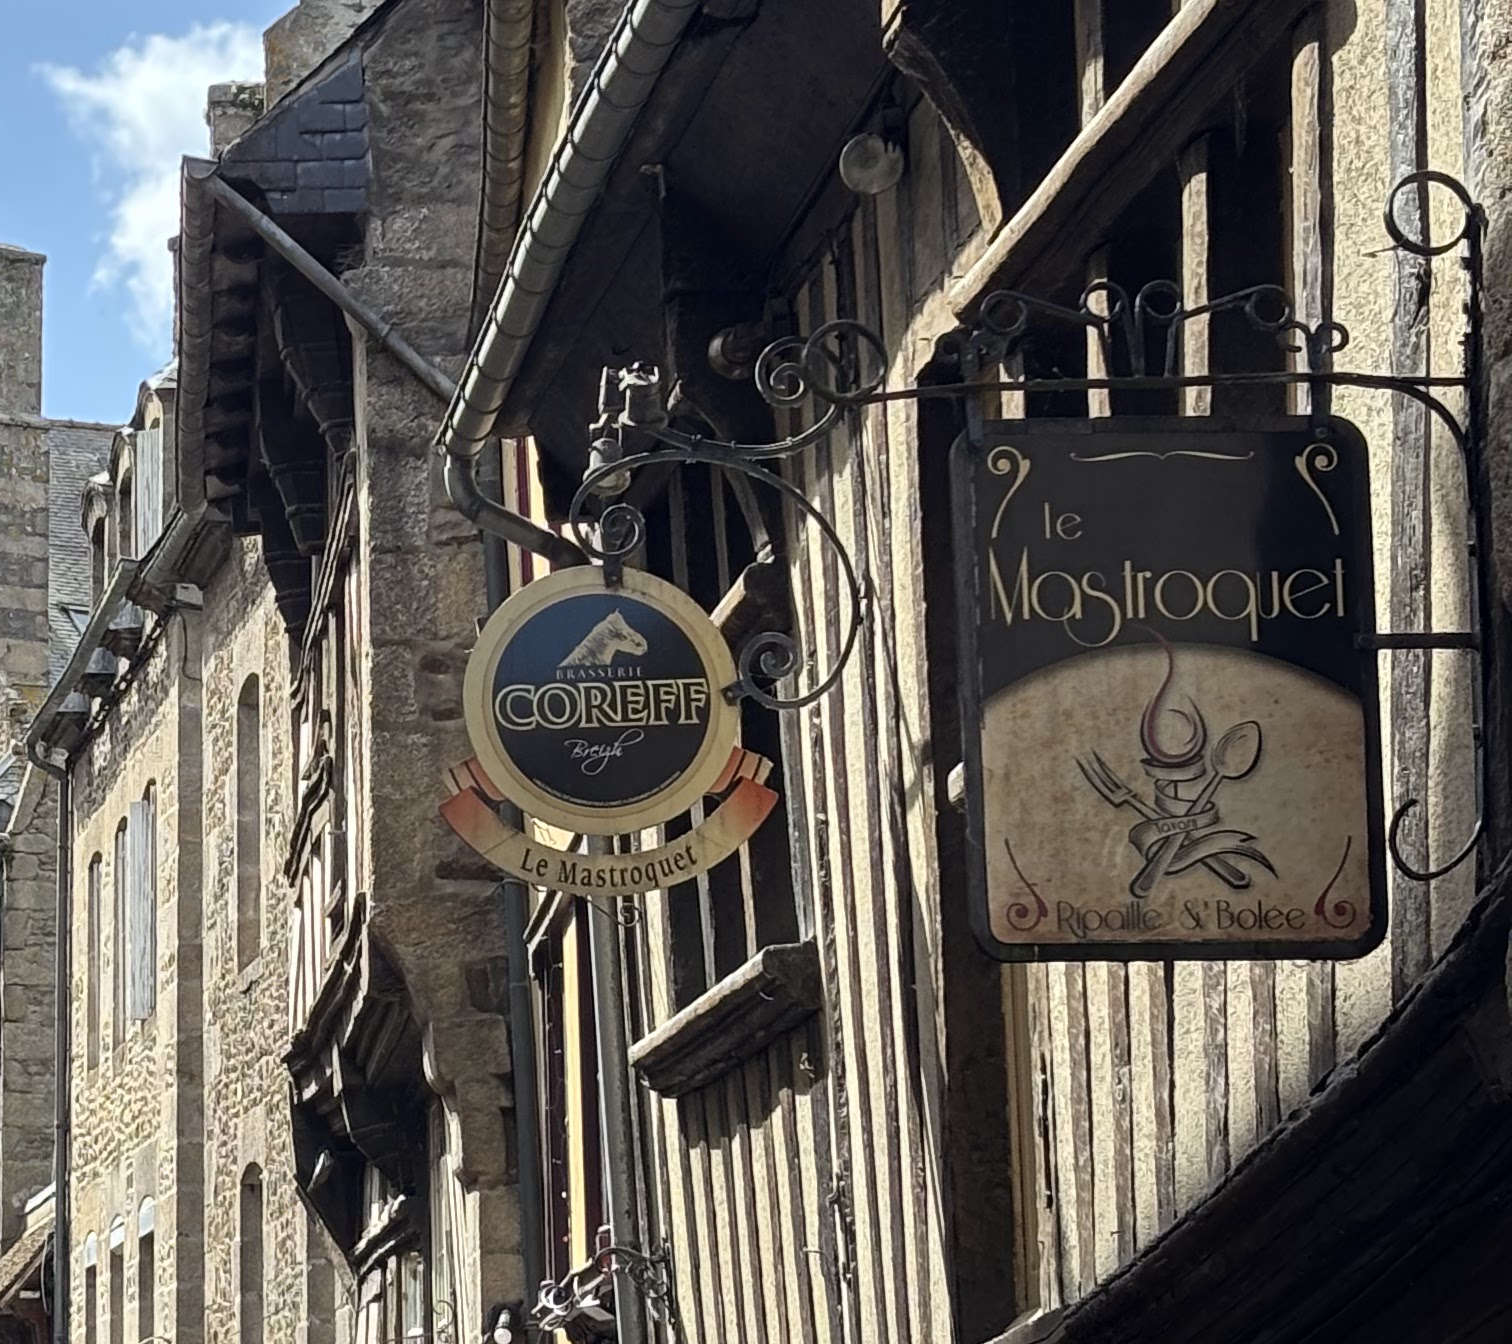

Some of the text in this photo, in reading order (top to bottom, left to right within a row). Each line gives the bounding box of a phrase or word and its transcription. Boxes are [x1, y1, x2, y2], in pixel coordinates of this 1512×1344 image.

[1044, 502, 1083, 541] le
[988, 545, 1347, 647] Mastroquet
[556, 666, 643, 680] BRASSERIE
[494, 677, 710, 731] COREFF
[563, 728, 645, 776] Breizh
[519, 843, 698, 888] Le Mastroquet
[1056, 899, 1162, 939] Ripaille
